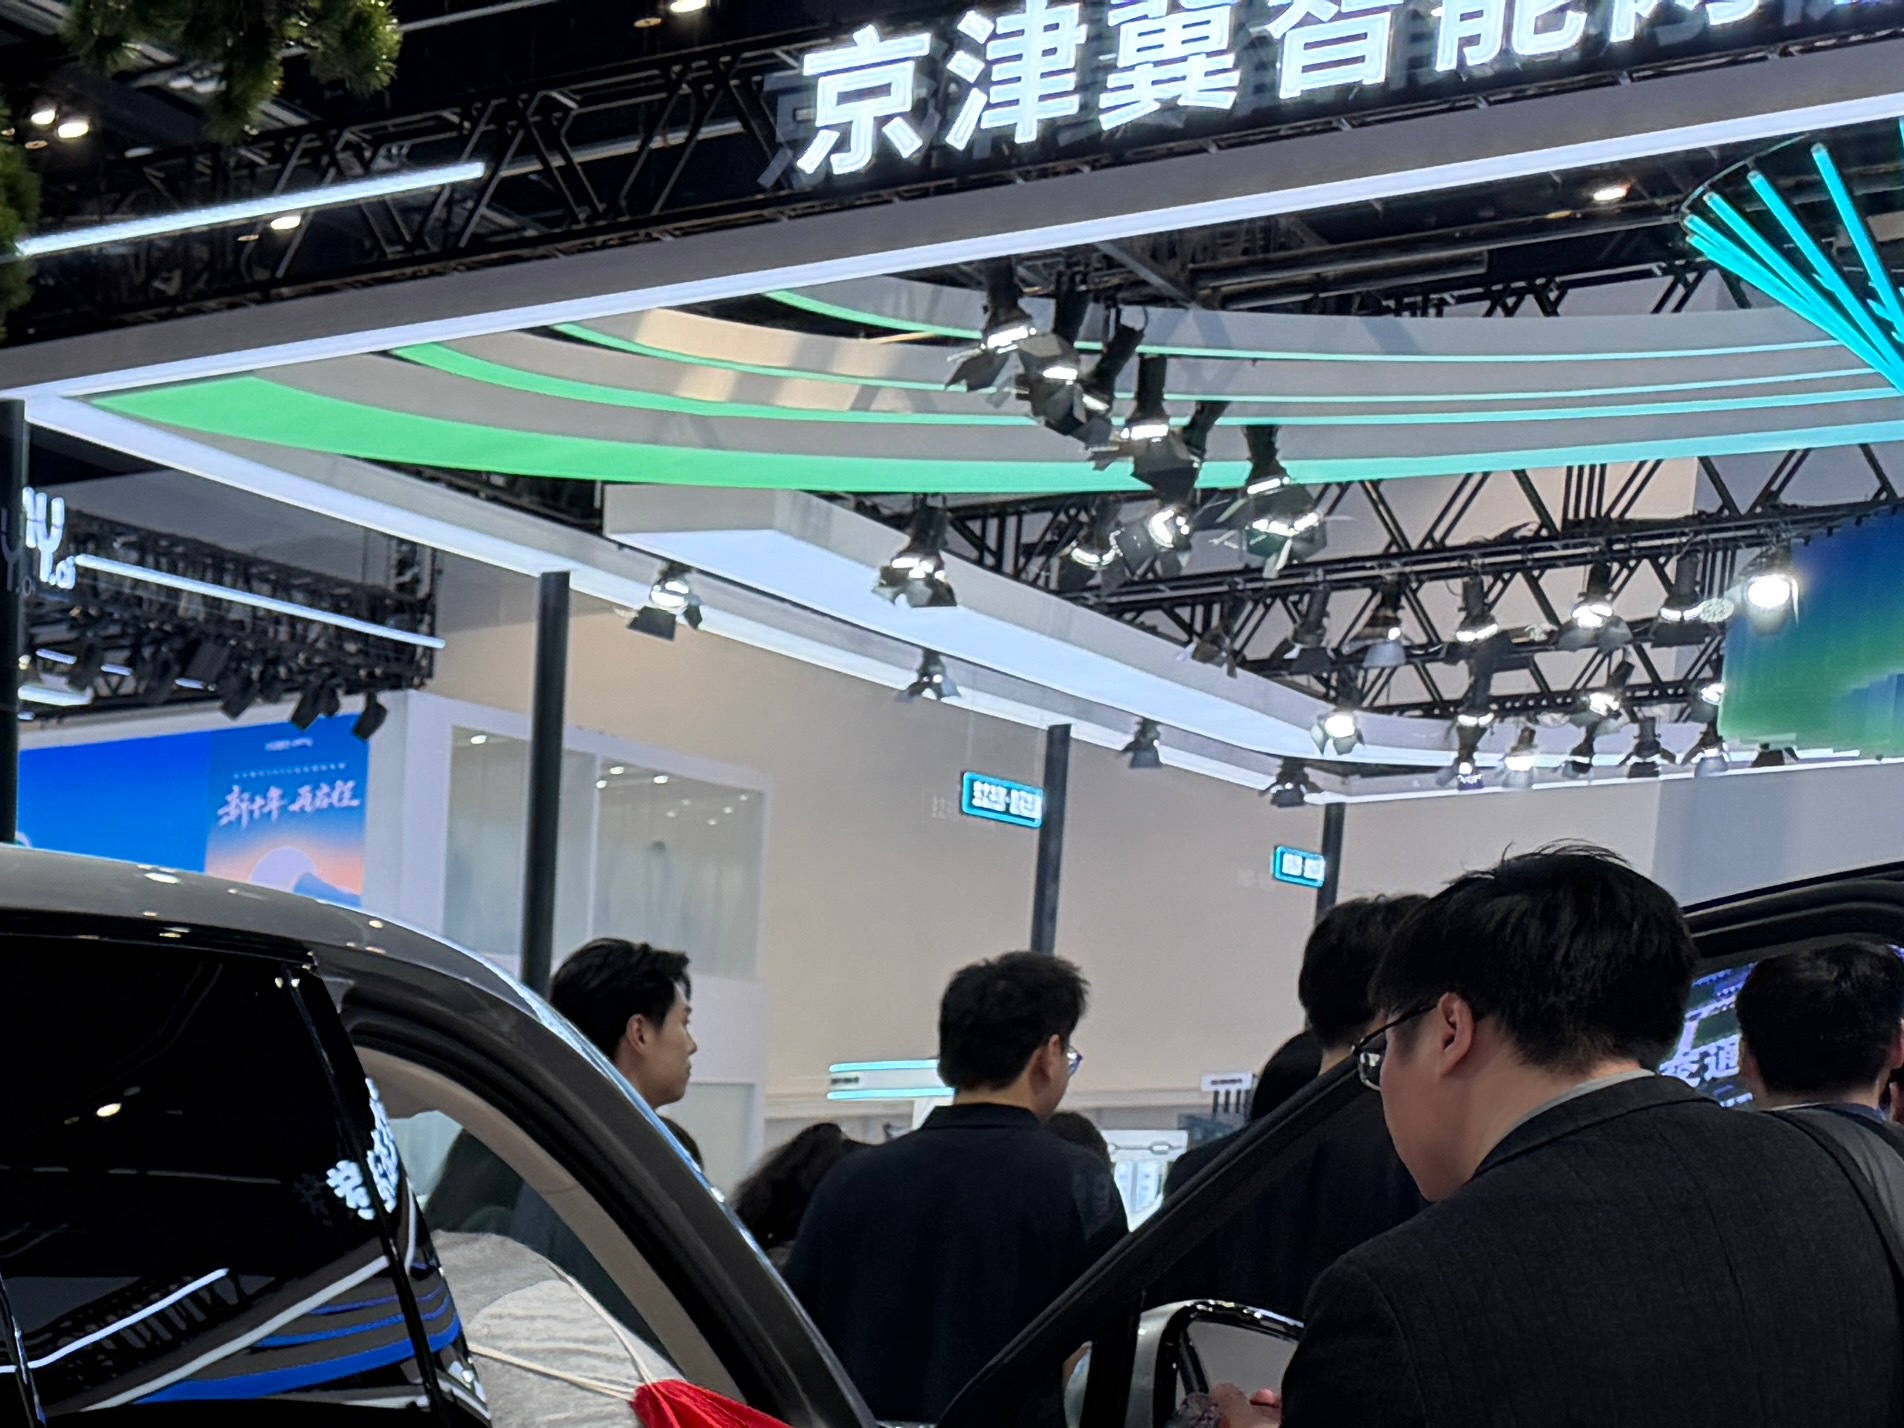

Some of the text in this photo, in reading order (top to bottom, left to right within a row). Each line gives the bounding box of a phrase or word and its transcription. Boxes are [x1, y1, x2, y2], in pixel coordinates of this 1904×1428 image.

[796, 0, 1764, 177] 京津冀智能
